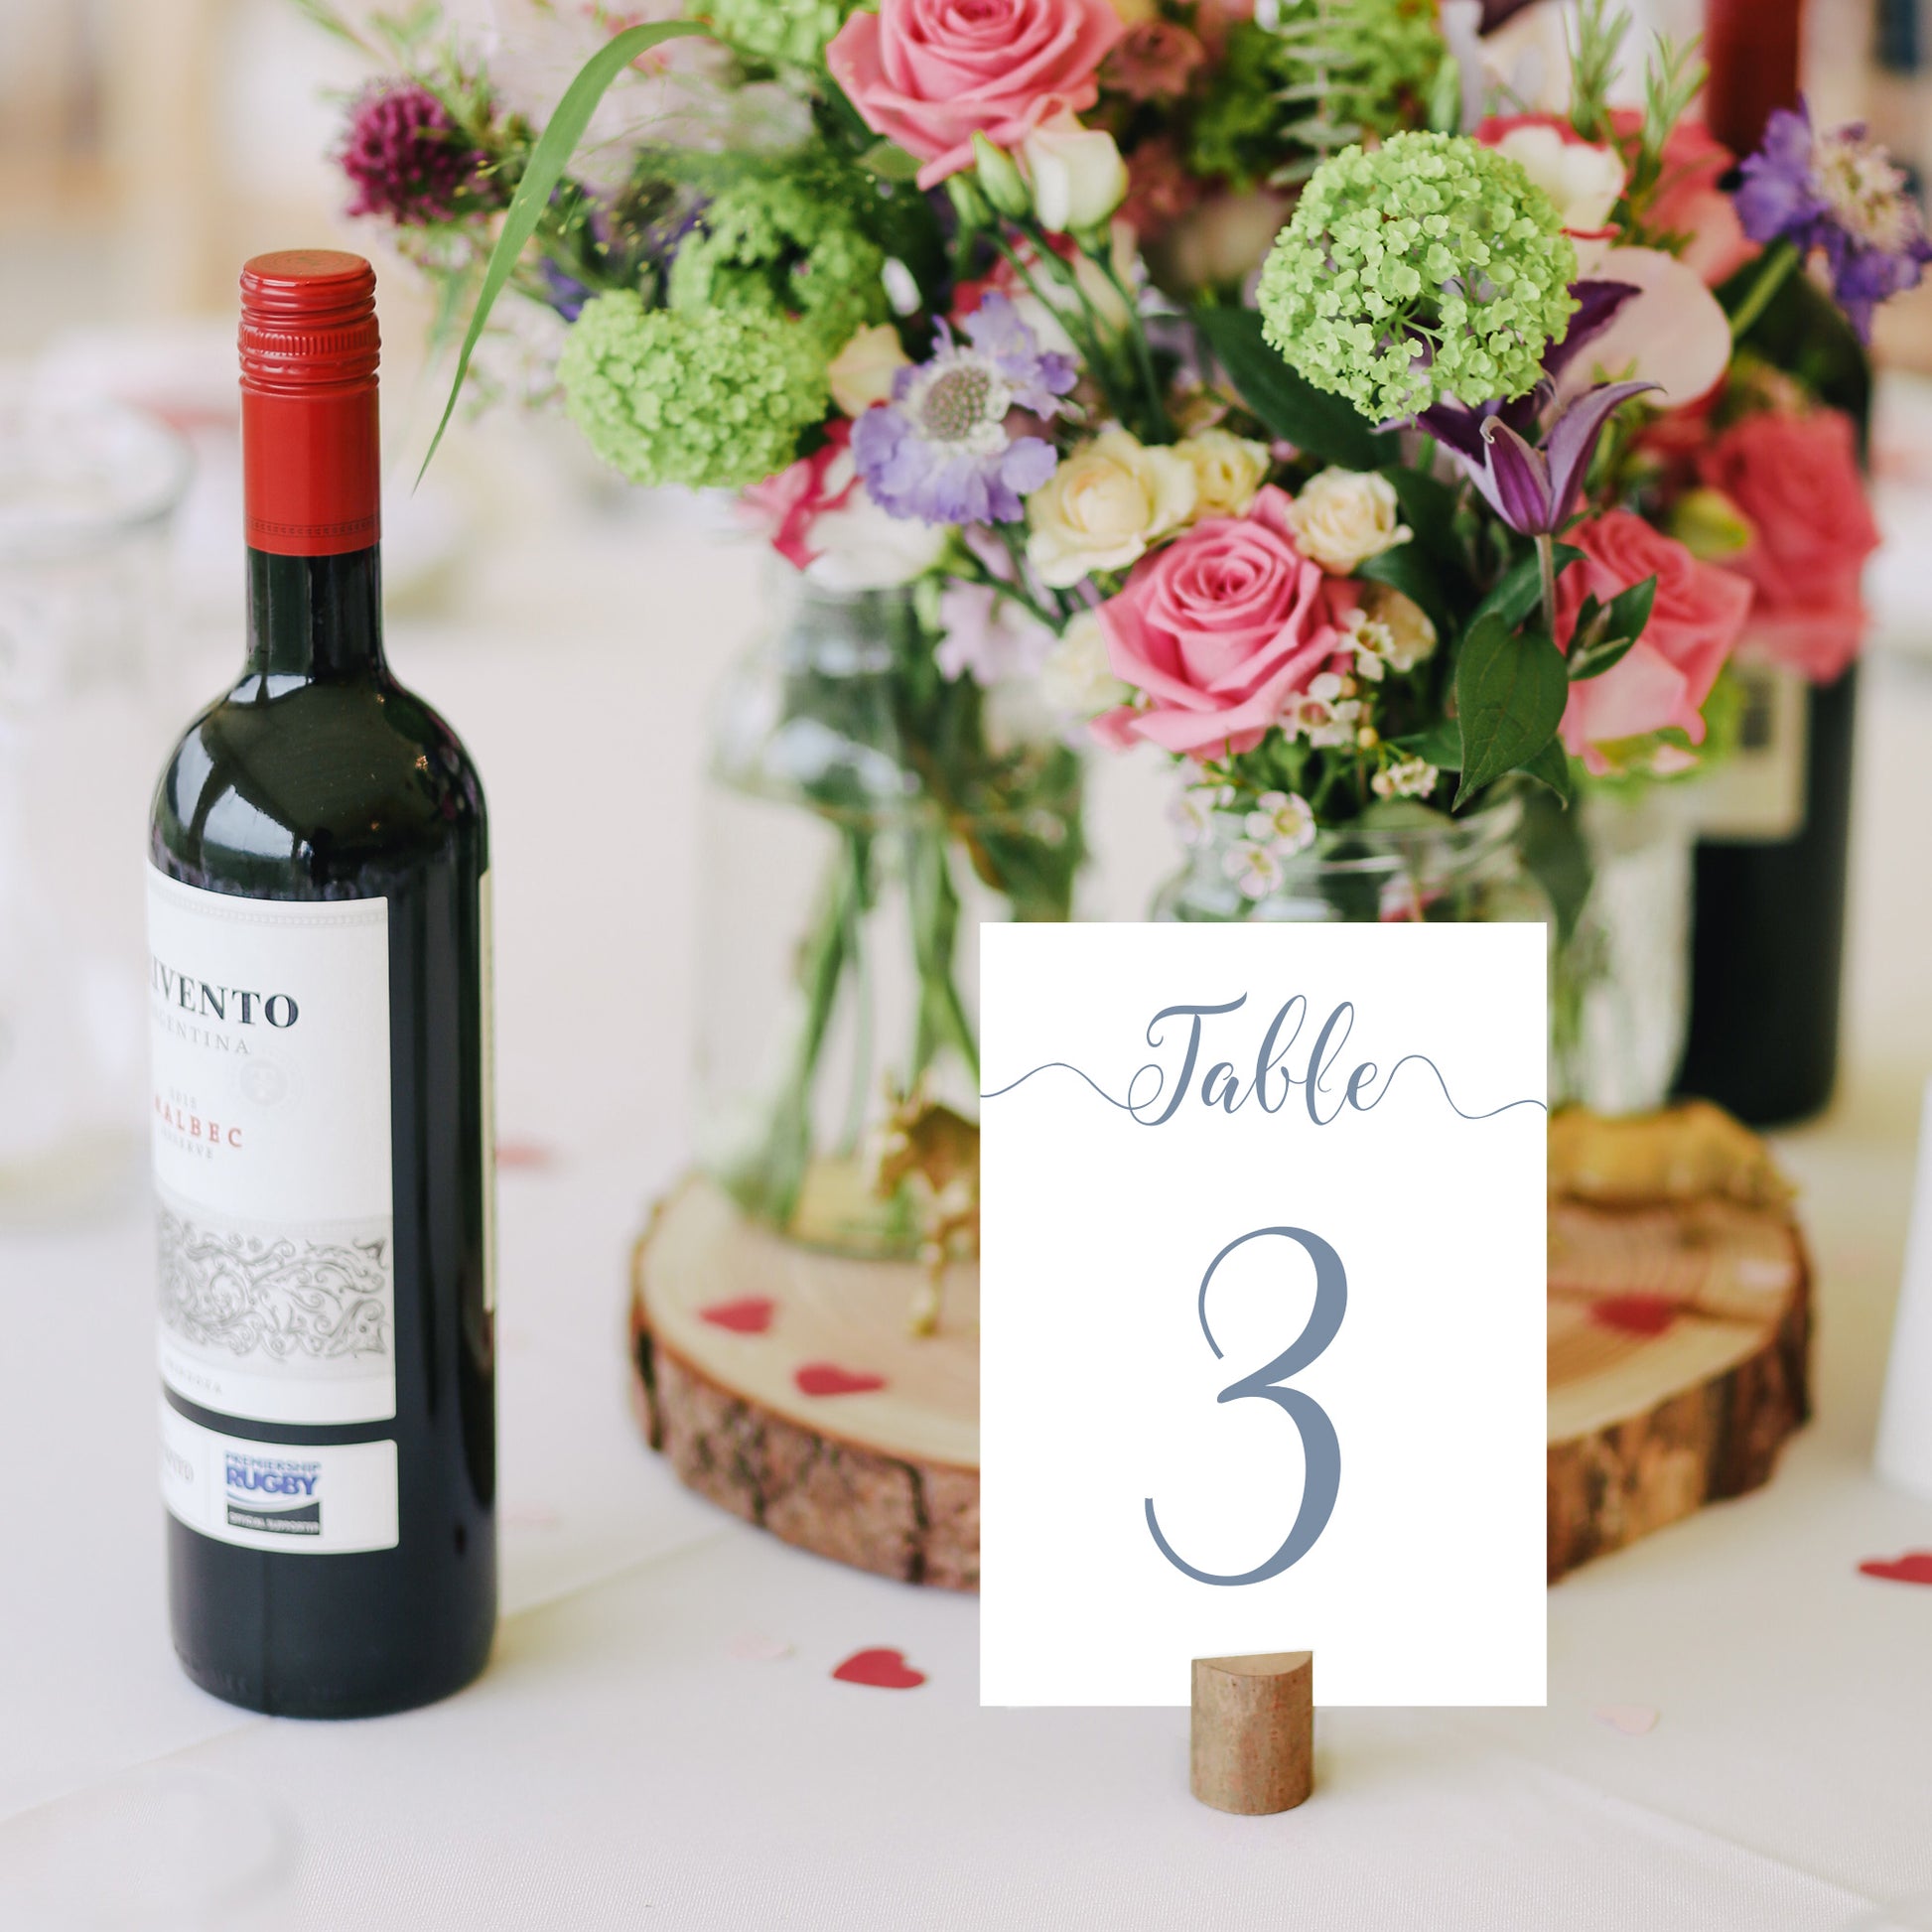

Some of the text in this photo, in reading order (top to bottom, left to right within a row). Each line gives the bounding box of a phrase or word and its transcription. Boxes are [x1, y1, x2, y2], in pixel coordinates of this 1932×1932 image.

[1129, 991, 1395, 1126] Table
[1145, 1226, 1348, 1587] 3
[226, 1466, 318, 1495] RUGBY
